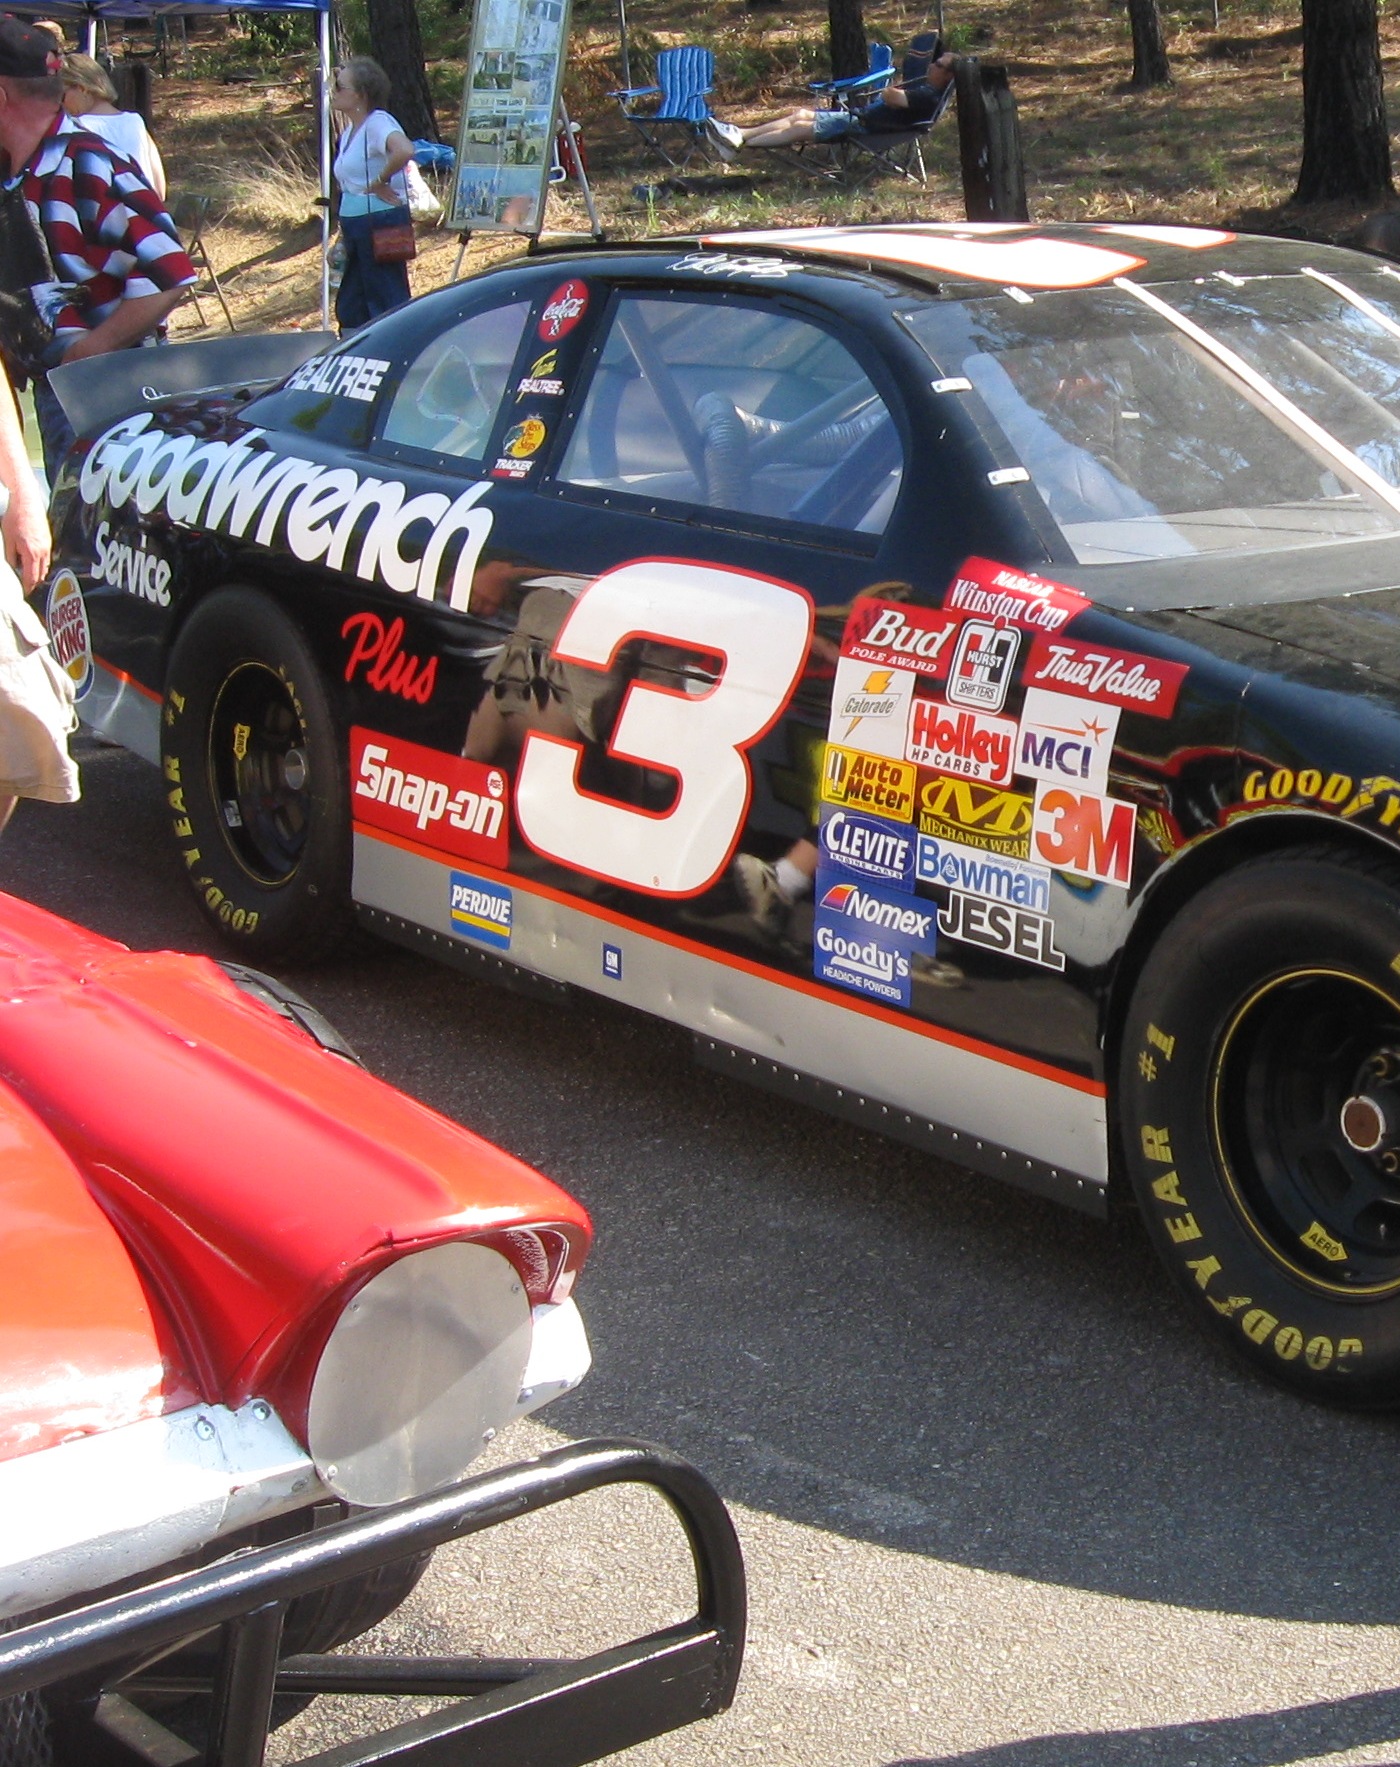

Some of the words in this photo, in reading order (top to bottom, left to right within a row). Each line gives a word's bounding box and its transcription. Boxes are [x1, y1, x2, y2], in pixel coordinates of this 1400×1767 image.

[283, 355, 391, 402] REALTREE
[517, 378, 565, 396] REALTREE
[495, 458, 535, 471] TRACKER
[80, 412, 494, 613] Goodwrench
[91, 521, 172, 607] Service
[992, 570, 1055, 597] NASCAR
[51, 597, 83, 636] BURGER
[950, 579, 1027, 620] Winston
[1024, 598, 1069, 632] Cup
[56, 619, 86, 667] KING
[341, 611, 440, 704] Plus
[861, 608, 957, 659] Bud
[848, 646, 888, 662] POLE
[886, 655, 937, 674] AWARD
[967, 650, 1004, 669] HURST
[844, 697, 894, 714] Gatorade
[958, 681, 996, 699] SHIFTERS
[514, 556, 815, 899] 3
[911, 702, 1012, 782] Holley
[849, 755, 903, 787] Auto
[911, 747, 930, 762] HP
[934, 753, 982, 776] CARBS
[1021, 731, 1093, 779] MCI
[355, 743, 505, 840] Snap-on
[846, 775, 910, 810] Meter
[826, 811, 910, 871] CLEVITE
[919, 812, 988, 851] MECHANIX
[988, 836, 1030, 860] WEAR
[1035, 788, 1133, 882] 3M
[451, 884, 513, 924] PERDUE
[845, 890, 932, 938] Nomex
[817, 927, 910, 982] Goody's
[938, 891, 1065, 971] JESEL
[823, 965, 863, 988] HEADACHE
[862, 978, 902, 1001] POWDERS
[1137, 1023, 1177, 1082] #1
[1307, 1230, 1340, 1260] AERO
